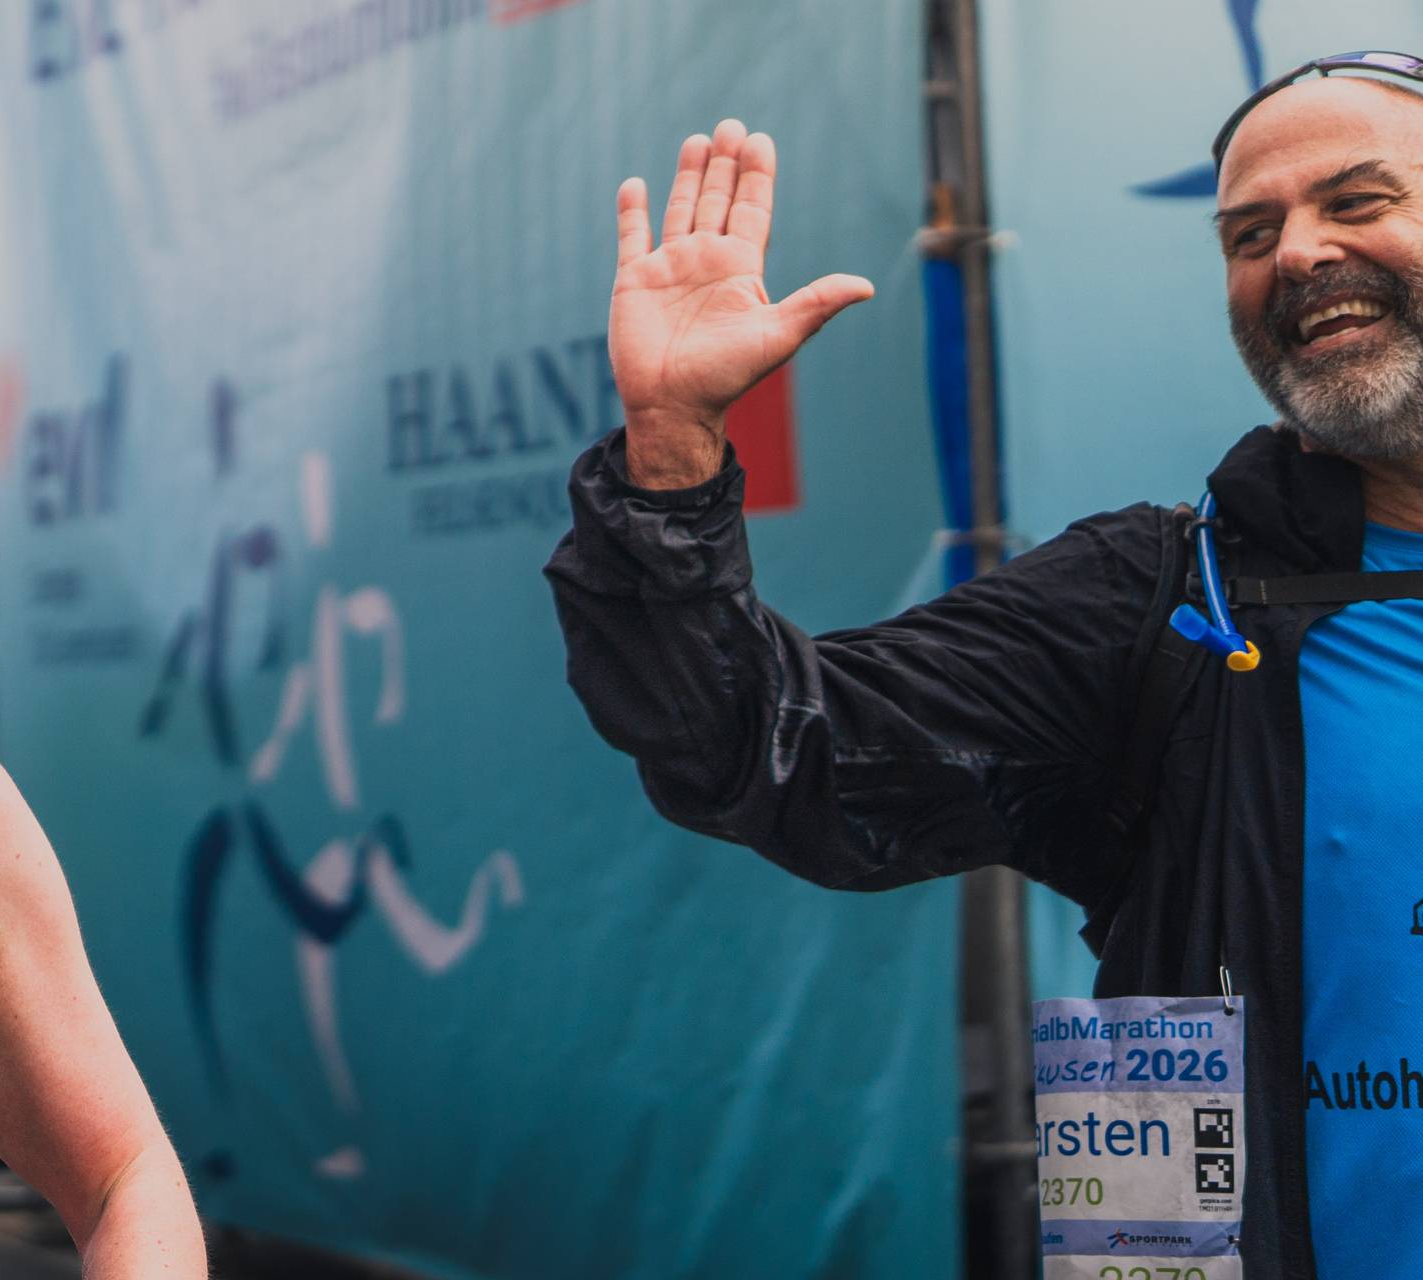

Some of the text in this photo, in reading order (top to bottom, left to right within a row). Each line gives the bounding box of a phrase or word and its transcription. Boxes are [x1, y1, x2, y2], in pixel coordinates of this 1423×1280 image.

[1127, 1048, 1228, 1082] 2026
[1041, 1177, 1104, 1206] 2370
[1128, 1235, 1192, 1244] SPORTPARK
